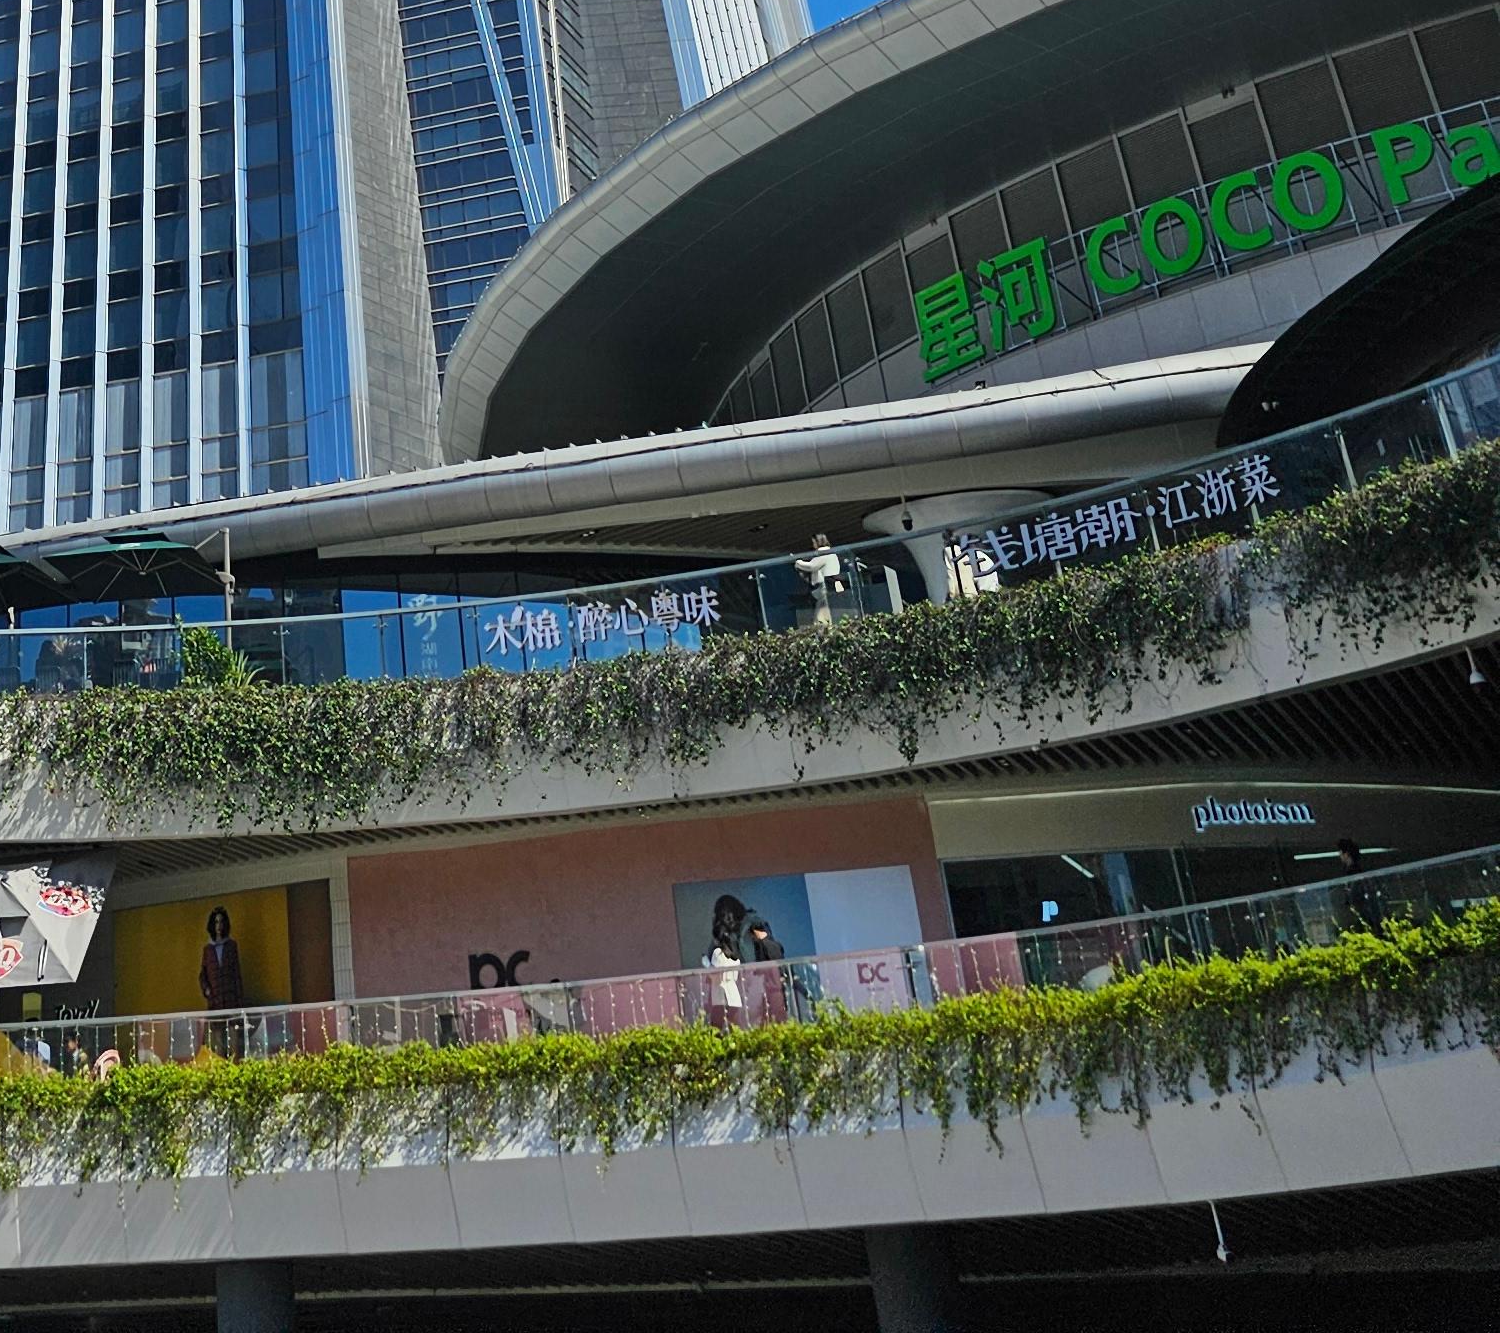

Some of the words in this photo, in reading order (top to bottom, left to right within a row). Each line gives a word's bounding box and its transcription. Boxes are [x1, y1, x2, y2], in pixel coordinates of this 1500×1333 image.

[914, 236, 1057, 383] 星河
[1086, 151, 1346, 297] COCO
[1192, 795, 1316, 832] photoism
